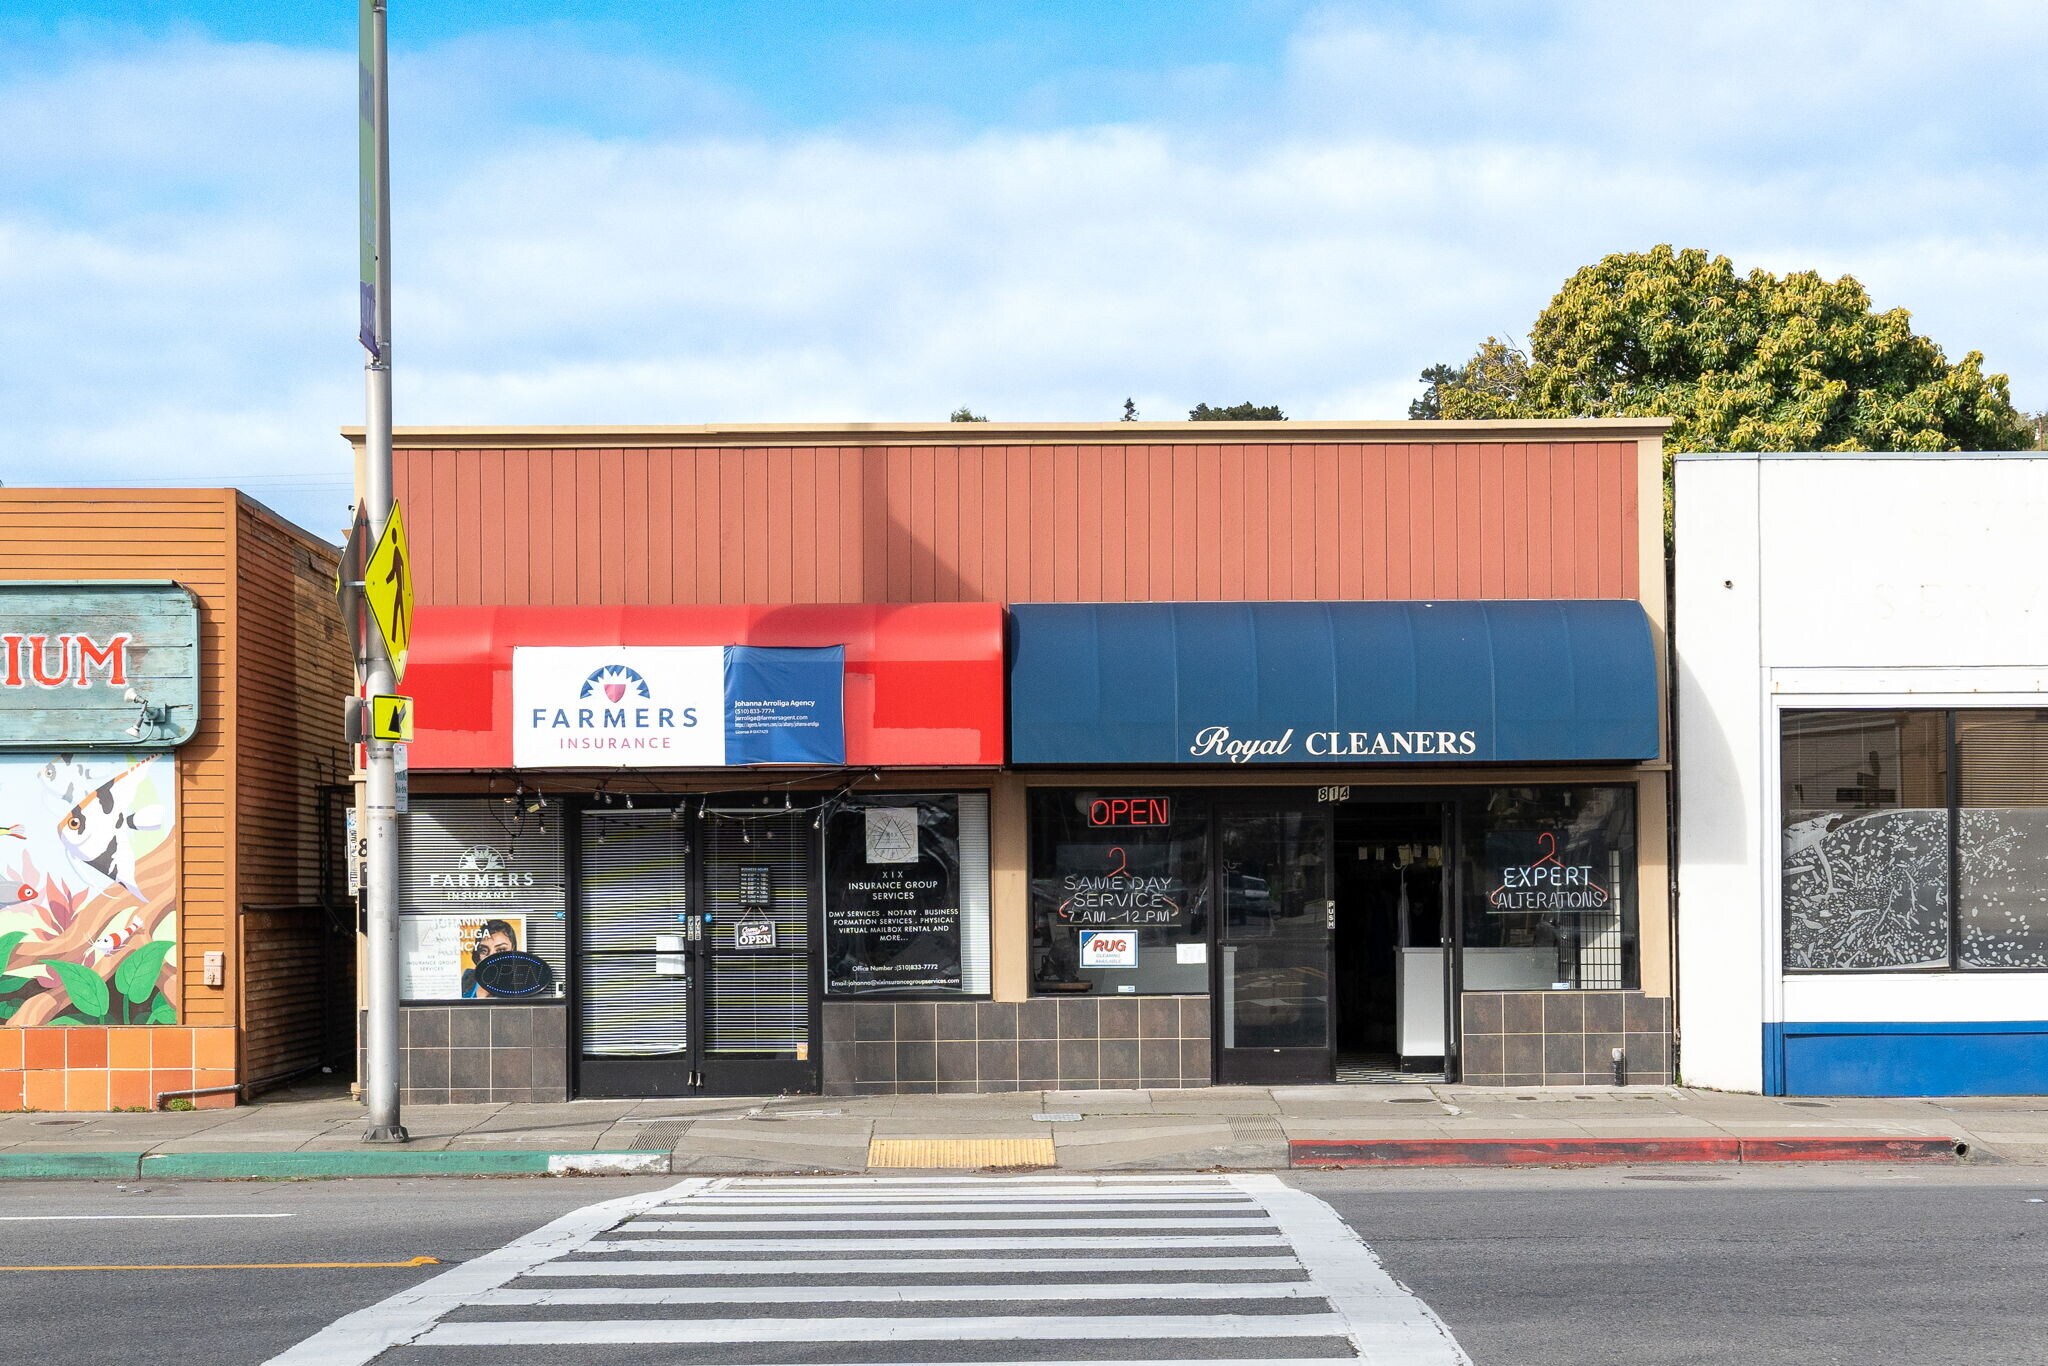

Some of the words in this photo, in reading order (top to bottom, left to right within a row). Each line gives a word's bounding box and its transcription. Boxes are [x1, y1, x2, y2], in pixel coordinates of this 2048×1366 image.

[735, 700, 762, 708] Johanna
[763, 700, 789, 708] Arroliga
[790, 699, 815, 707] Agency
[533, 707, 699, 729] FARMERS
[559, 737, 672, 749] INSURANCE
[1190, 726, 1294, 763] Royal
[1305, 731, 1476, 755] CLEANERS
[1319, 787, 1349, 800] 814
[1090, 799, 1168, 825] OPEN
[430, 872, 534, 886] FARMERS
[1064, 876, 1124, 890] SAME
[1132, 876, 1173, 890] DAY
[1504, 866, 1592, 888] EXPERT
[848, 882, 902, 890] INSURANCE
[905, 881, 938, 889] GROUP
[872, 892, 915, 900] SERVICES
[1074, 893, 1164, 907] SERVICE
[1497, 890, 1603, 909] ALTERATIONS
[1068, 910, 1076, 922] 7
[1082, 911, 1106, 922] AM
[1126, 911, 1140, 923] 12
[1145, 910, 1170, 923] PM
[742, 926, 760, 935] Come
[739, 935, 772, 945] OPEN
[879, 934, 908, 942] MORE...
[1093, 939, 1127, 952] RUG
[481, 964, 543, 985] OPEN
